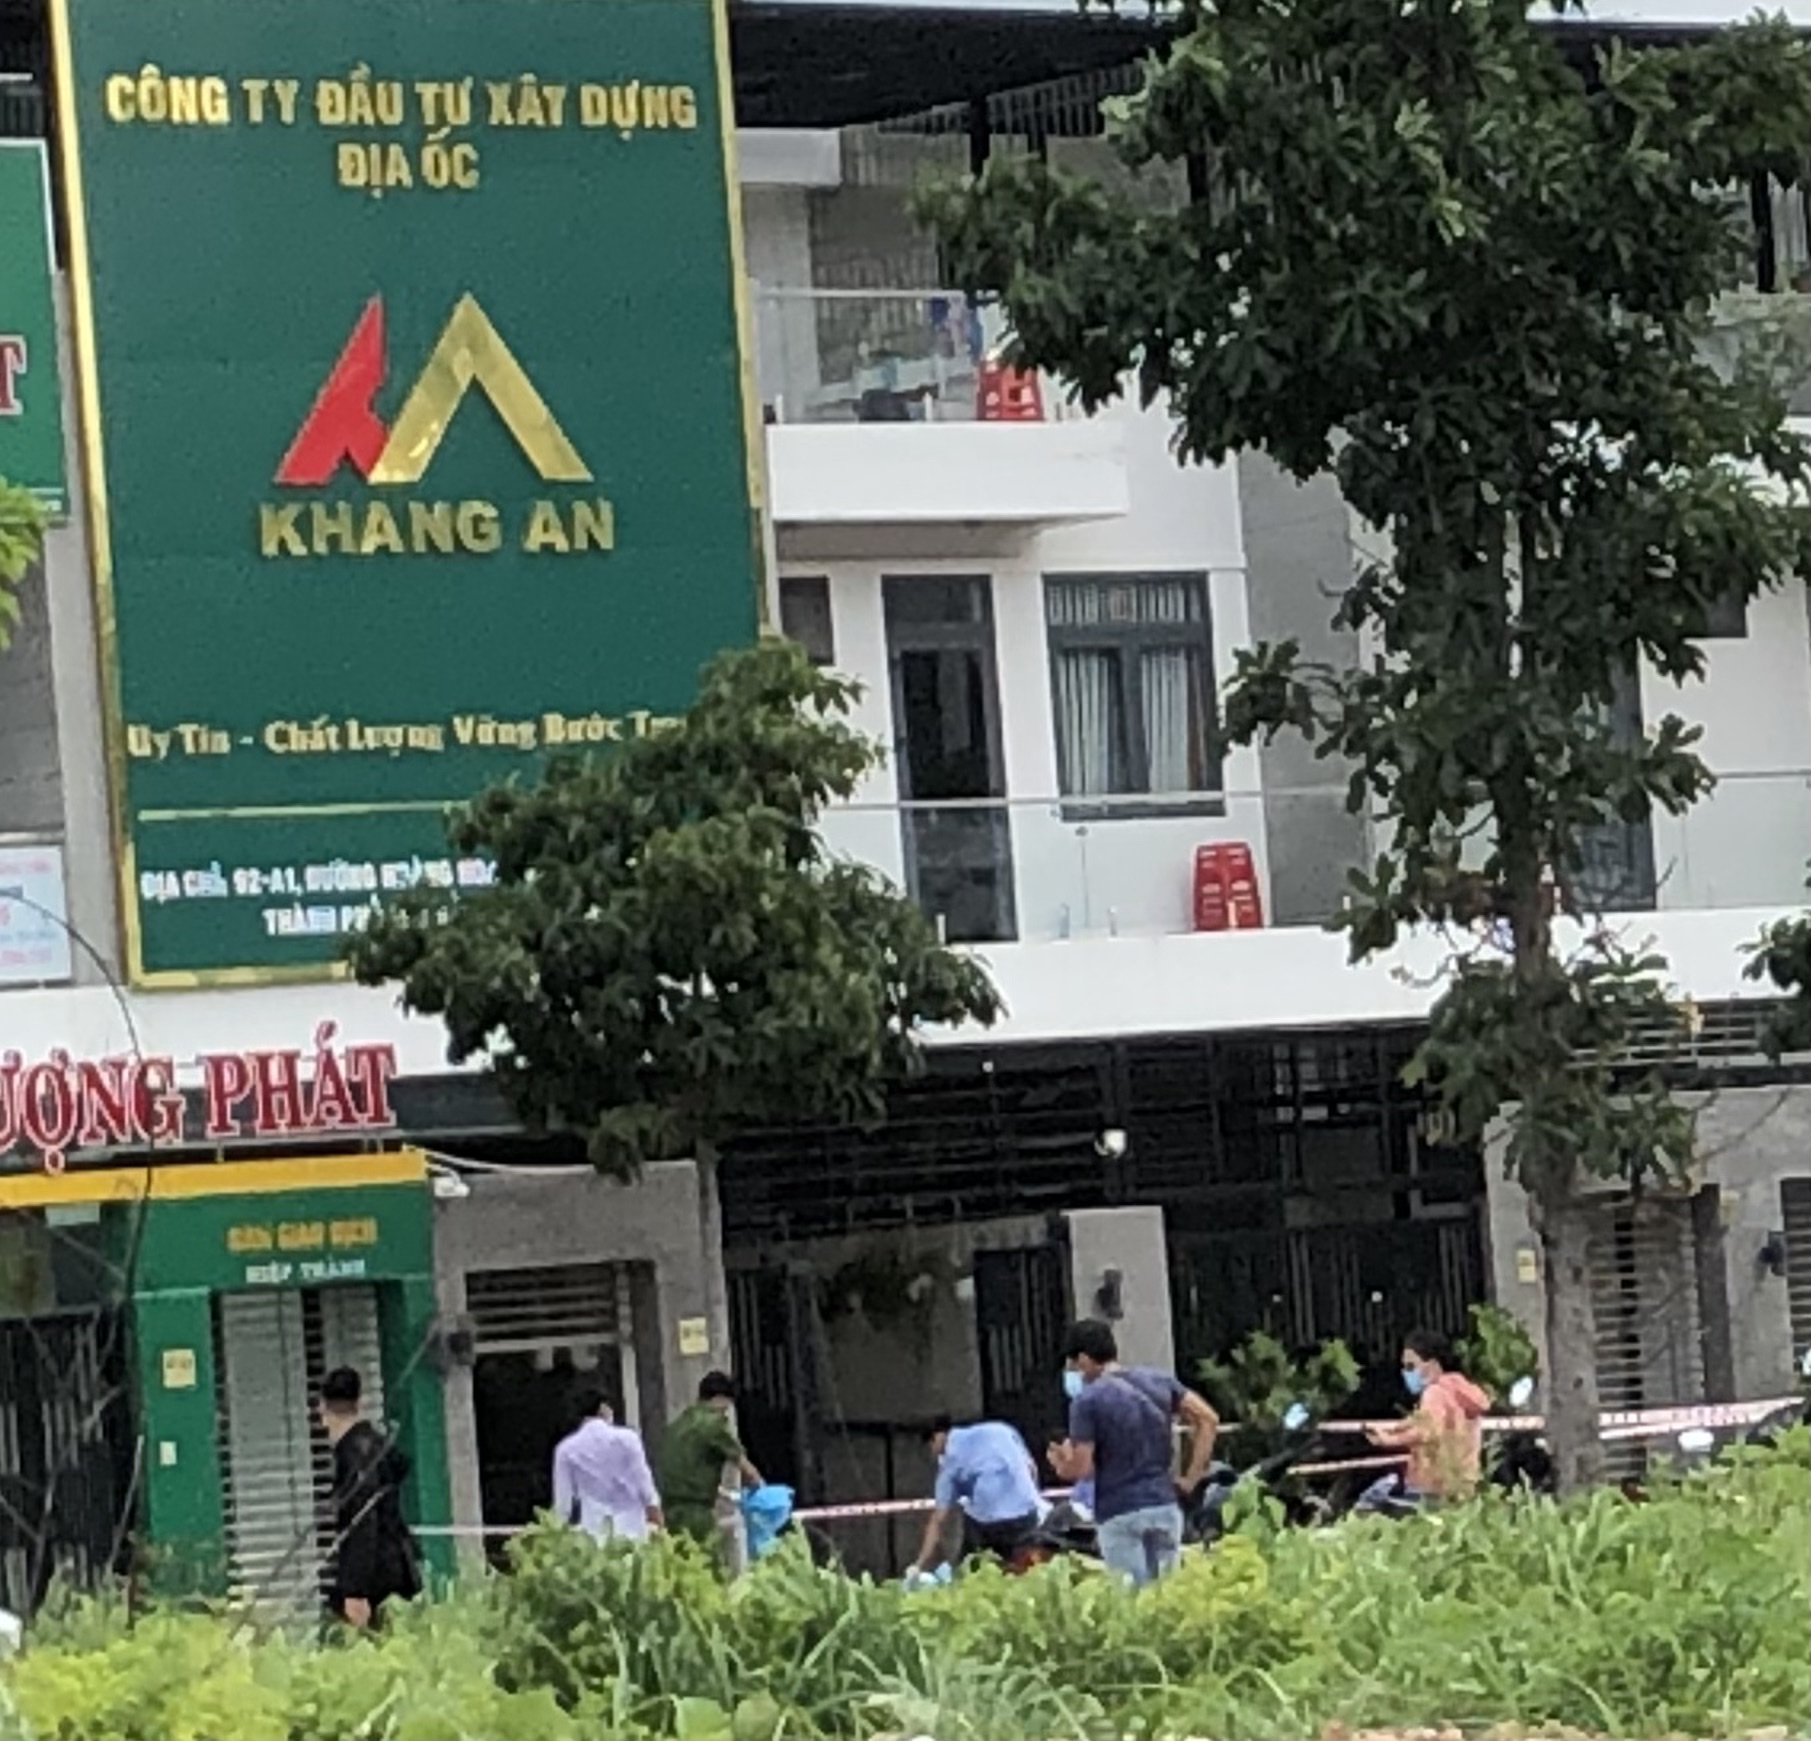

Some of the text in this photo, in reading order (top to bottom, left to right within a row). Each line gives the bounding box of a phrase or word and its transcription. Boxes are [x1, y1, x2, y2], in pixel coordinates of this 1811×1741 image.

[106, 60, 697, 141] CÔNG TY ĐẦU TƯ XÂY DỰNG
[336, 126, 480, 198] ĐỊA ỐC
[260, 497, 615, 558] KHANG AN
[264, 713, 340, 754] Chất
[203, 1020, 398, 1138] PHÁT
